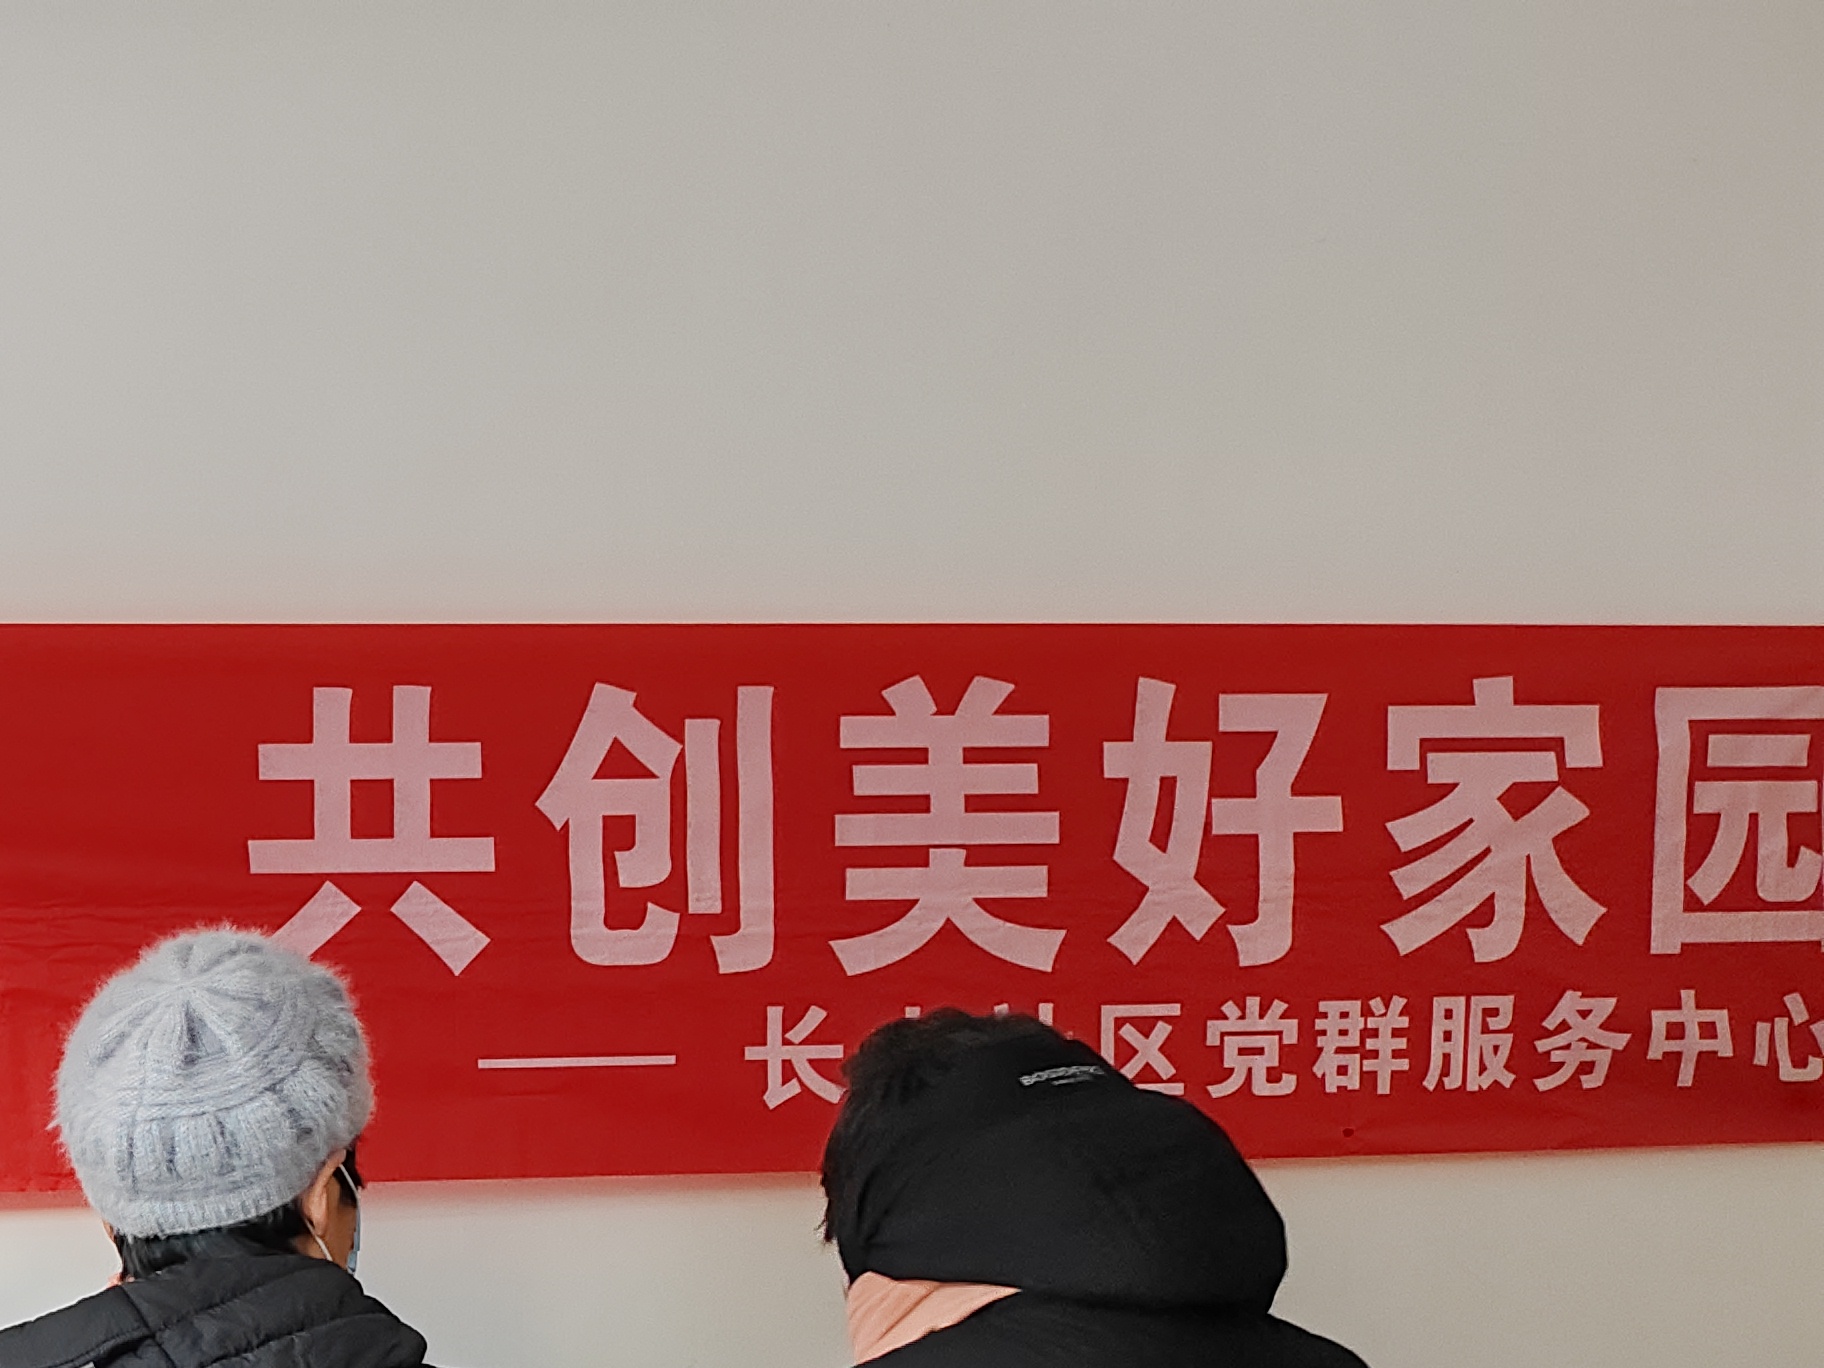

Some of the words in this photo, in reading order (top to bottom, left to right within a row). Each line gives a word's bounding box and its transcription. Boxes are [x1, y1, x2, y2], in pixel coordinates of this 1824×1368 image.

[248, 675, 1824, 977] 共创美好家园
[744, 989, 1824, 1110] 长区党群服务中心
